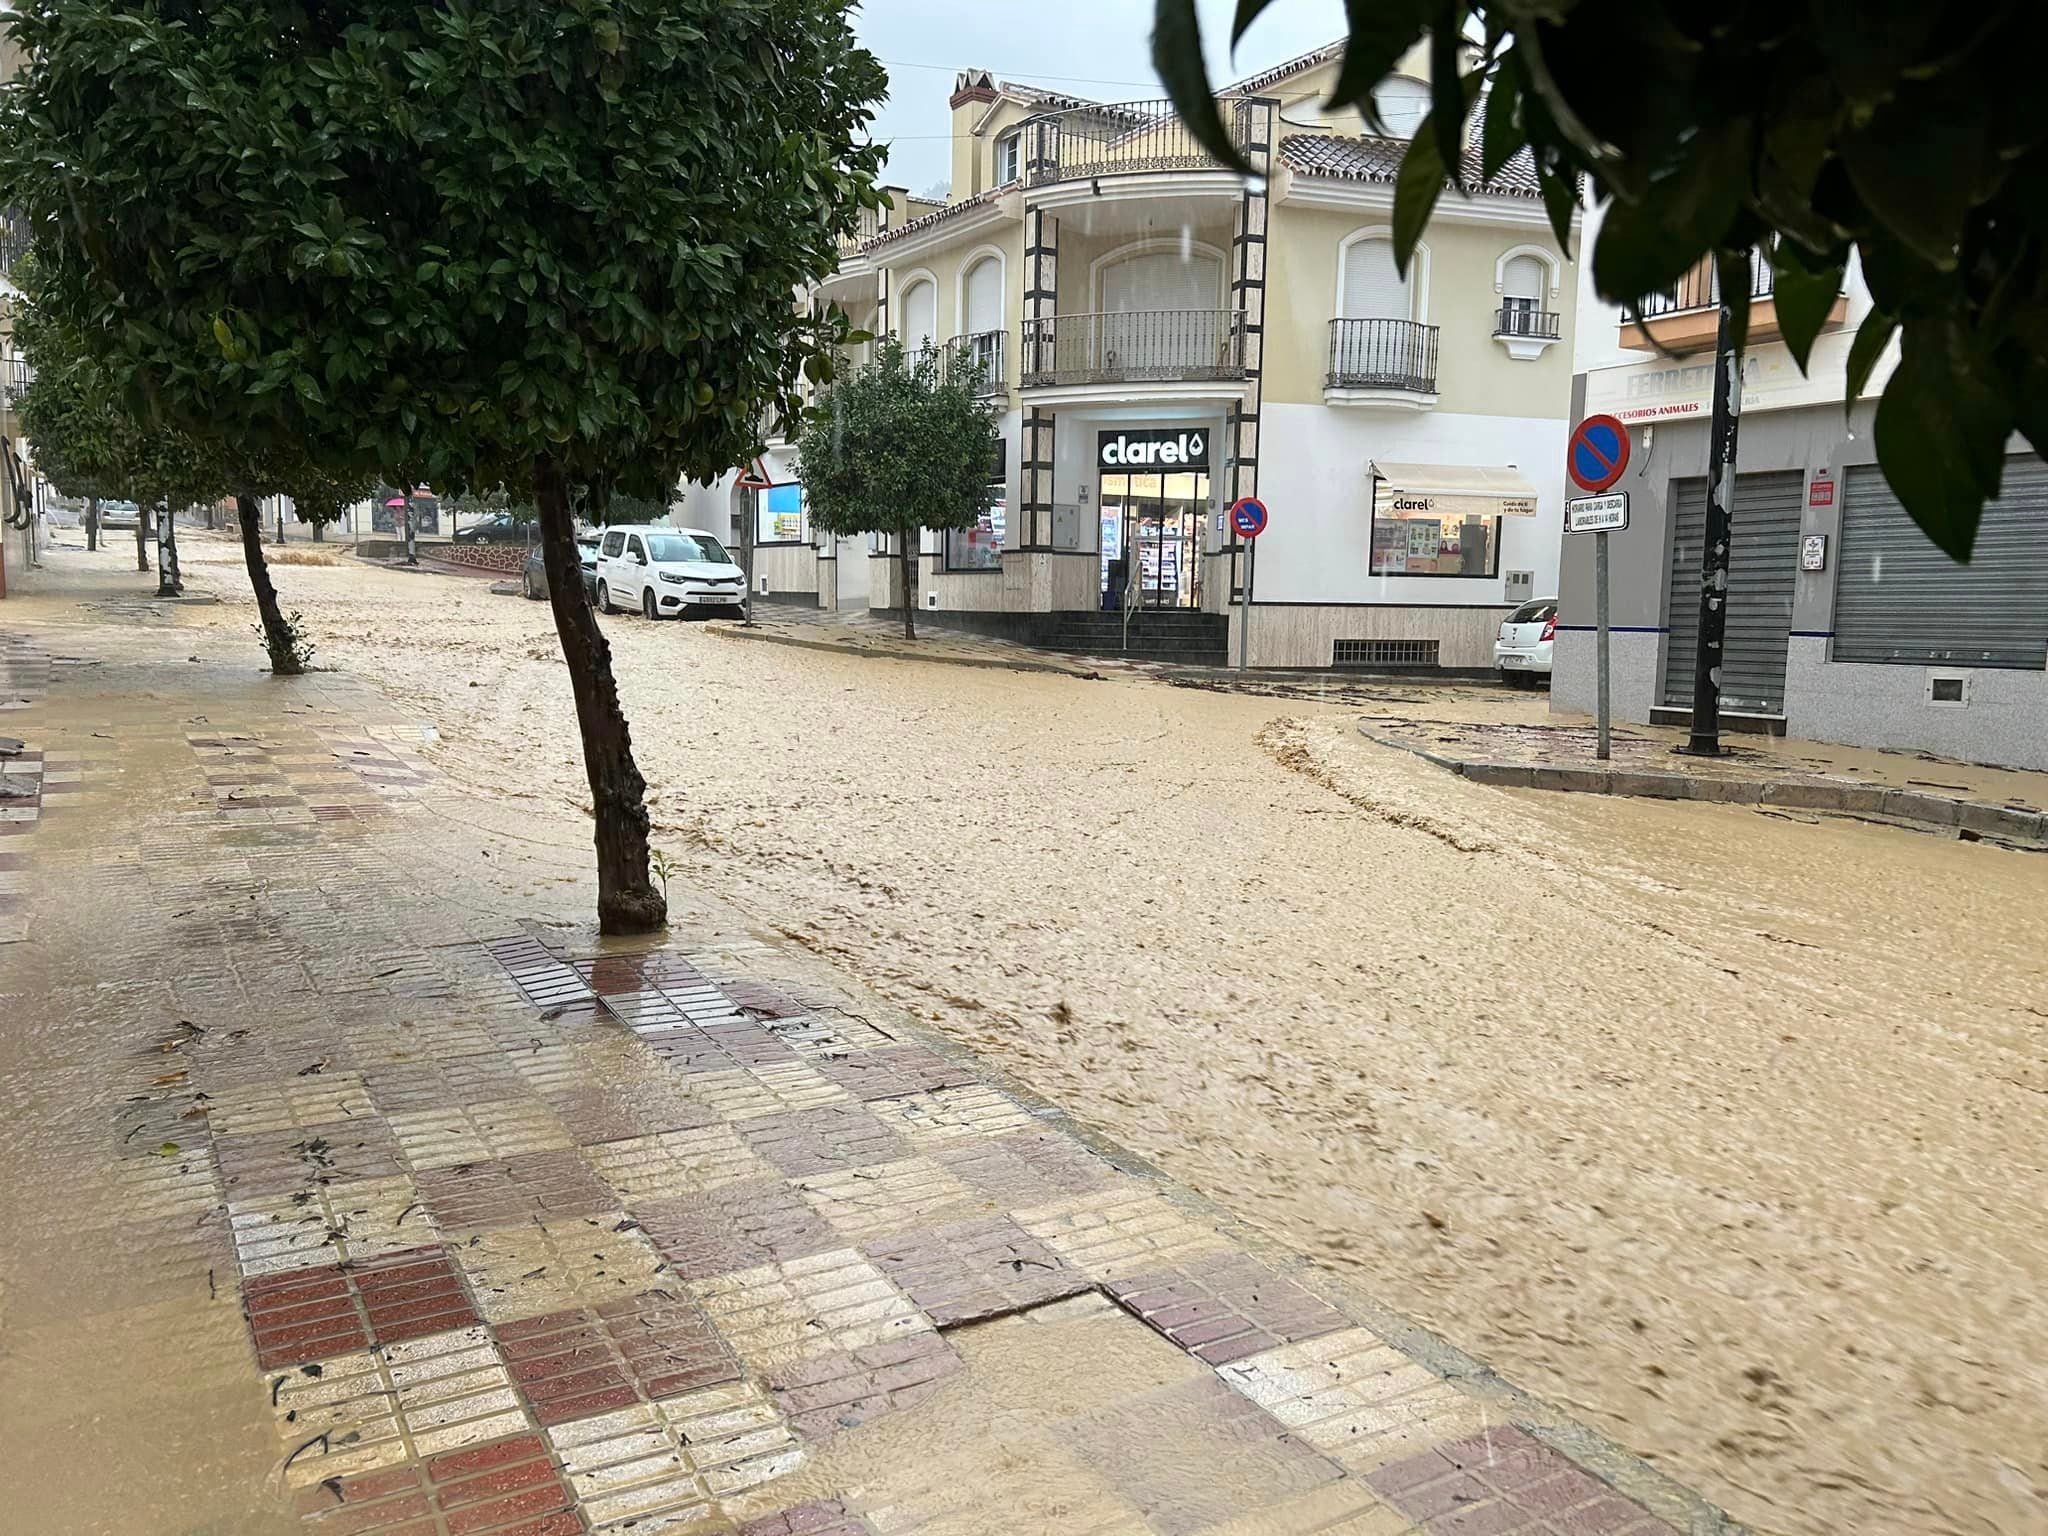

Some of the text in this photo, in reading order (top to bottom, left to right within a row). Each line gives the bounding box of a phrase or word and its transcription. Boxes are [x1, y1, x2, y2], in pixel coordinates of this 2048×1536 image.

[1658, 402, 1699, 416] ANIMALES
[1102, 433, 1189, 464] clarel
[1393, 498, 1429, 510] clarel
